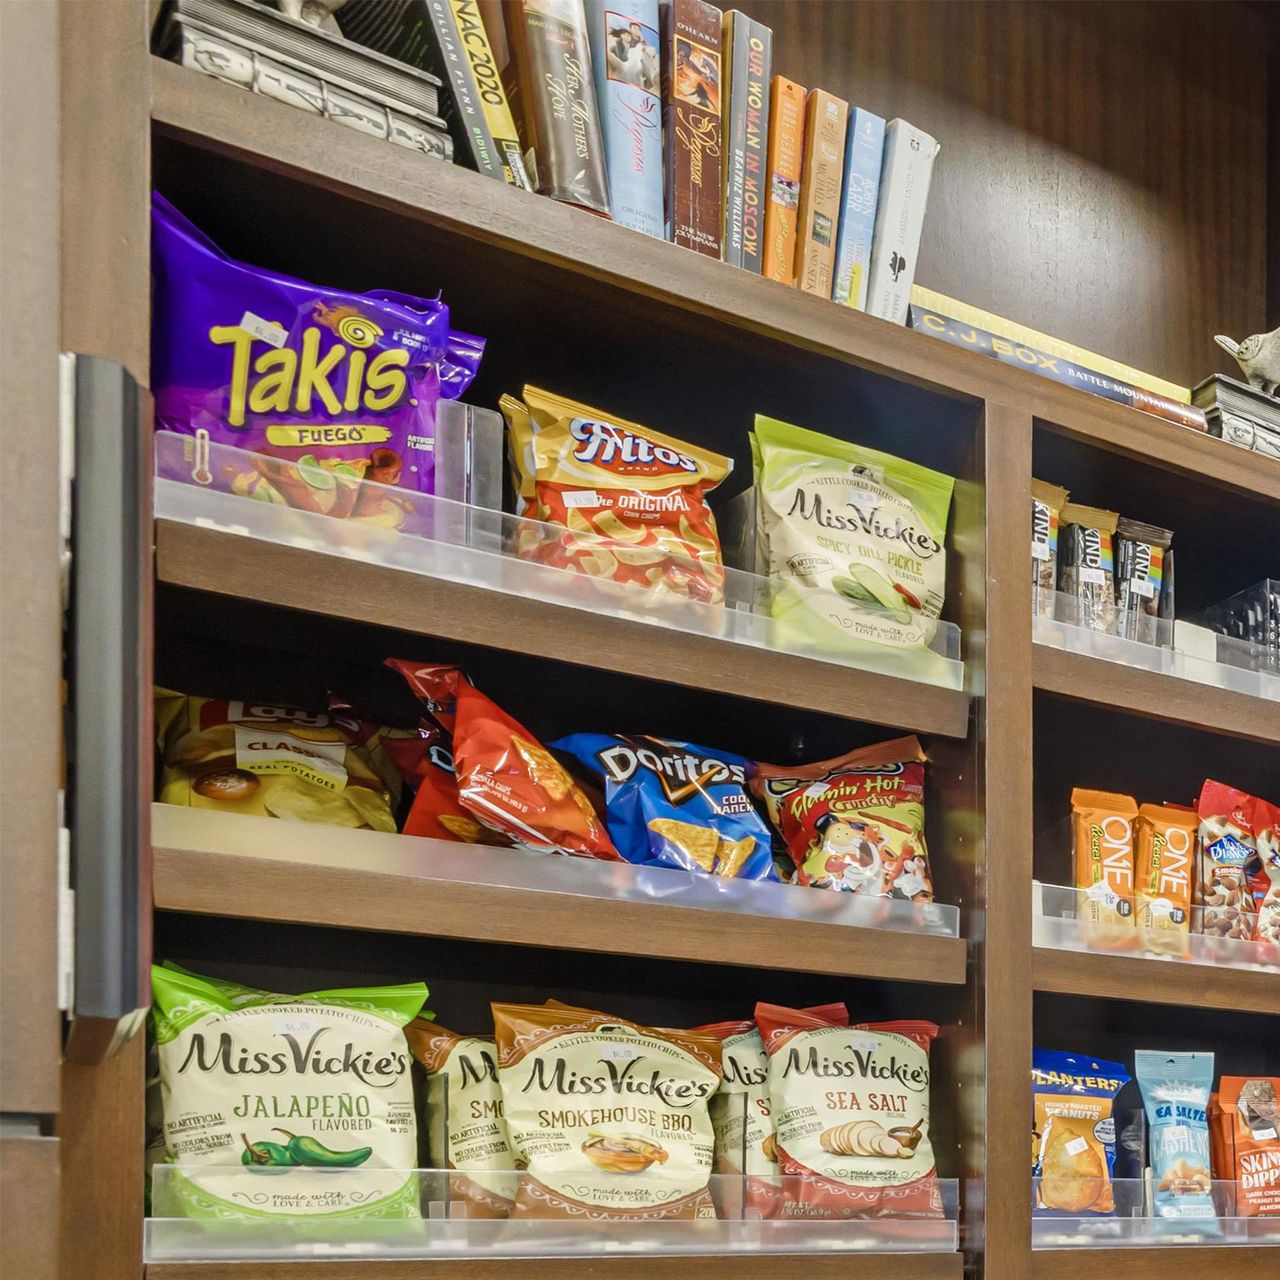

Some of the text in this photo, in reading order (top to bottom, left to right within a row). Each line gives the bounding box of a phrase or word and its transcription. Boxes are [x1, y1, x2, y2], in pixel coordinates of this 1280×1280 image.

[742, 37, 765, 257] OUR WOMAN IN MOSCOW
[730, 148, 747, 251] BEATRIZ WILLIAMS
[209, 318, 410, 427] Takis
[297, 426, 364, 444] FUEGO
[568, 416, 698, 474] Fritos
[816, 535, 923, 576] SPICY DILL PICKLE
[1084, 527, 1101, 569] KIND
[600, 746, 746, 785] Doritos
[1099, 815, 1132, 896] ONE
[1159, 827, 1191, 899] ONE
[178, 1026, 408, 1088] Miss Vickie's
[782, 1043, 930, 1092] Miss Vickie's
[521, 1053, 711, 1108] Miss Vickie's
[825, 1090, 908, 1113] SEA SALT
[233, 1093, 372, 1119] JALAPEÑO
[311, 1118, 373, 1131] FLAVORED
[538, 1108, 694, 1136] SMOKEHOUSE BBQ
[1044, 1107, 1100, 1121] PEANUTS
